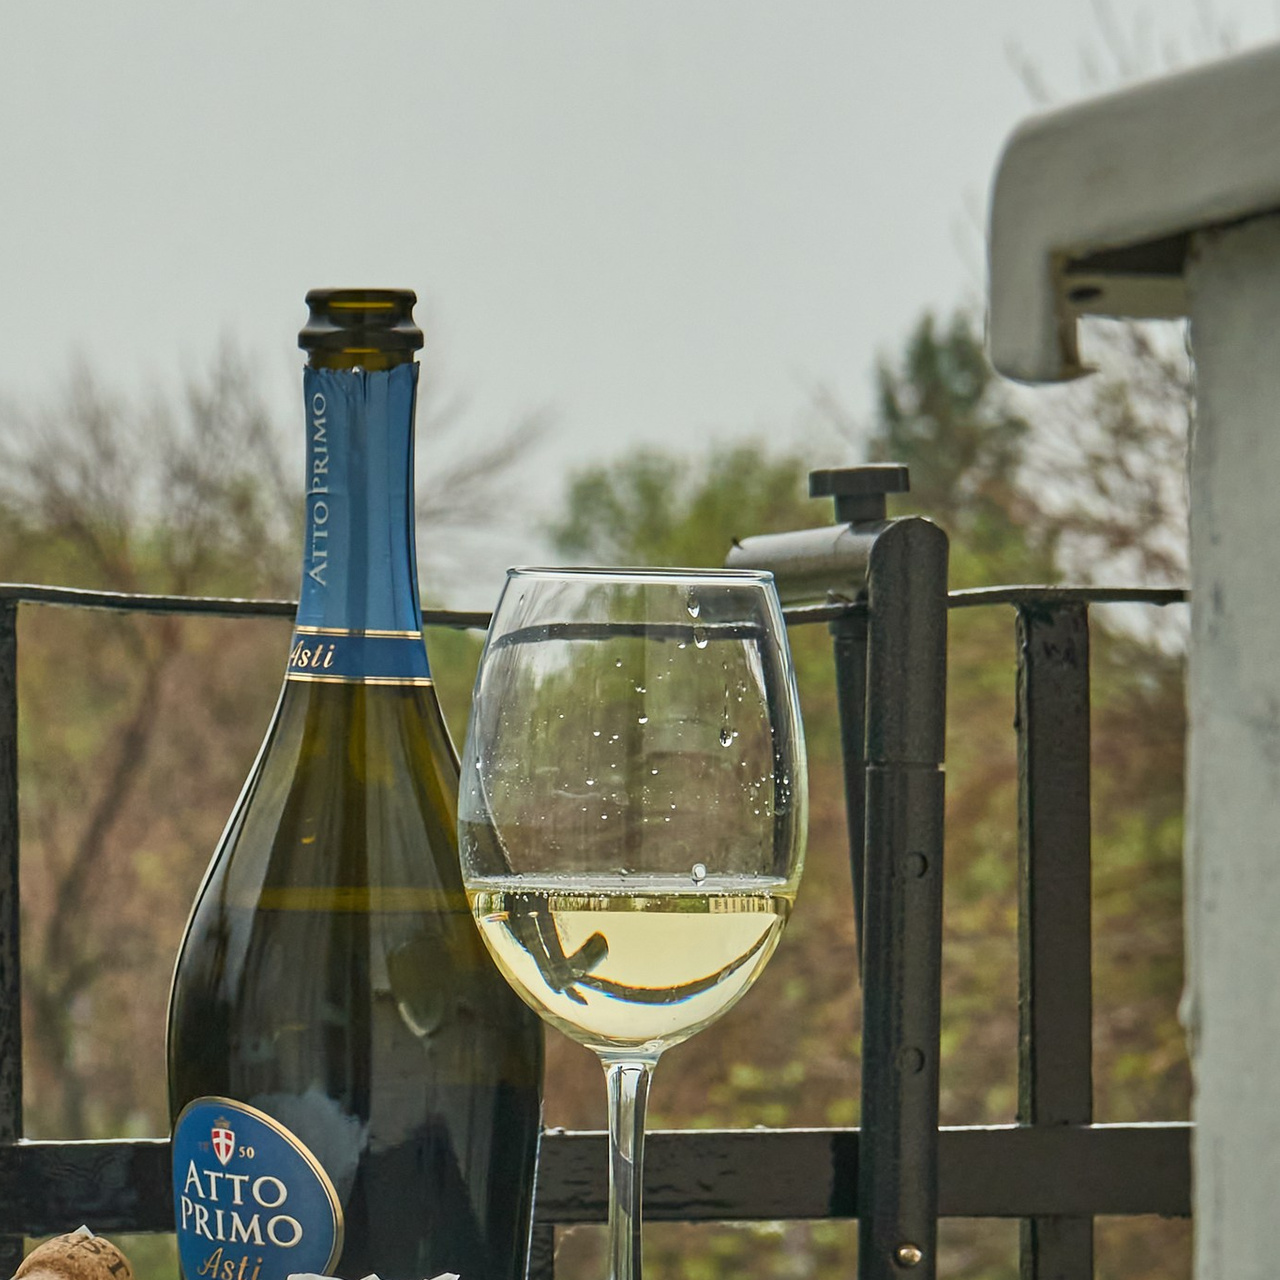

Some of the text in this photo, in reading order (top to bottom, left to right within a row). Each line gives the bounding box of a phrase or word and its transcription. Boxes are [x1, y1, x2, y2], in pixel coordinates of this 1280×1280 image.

[308, 391, 330, 587] ATTO PRIMO
[290, 639, 336, 668] Asti
[238, 1145, 255, 1159] 50
[183, 1159, 288, 1209] ATTO
[180, 1194, 303, 1248] PRIMO
